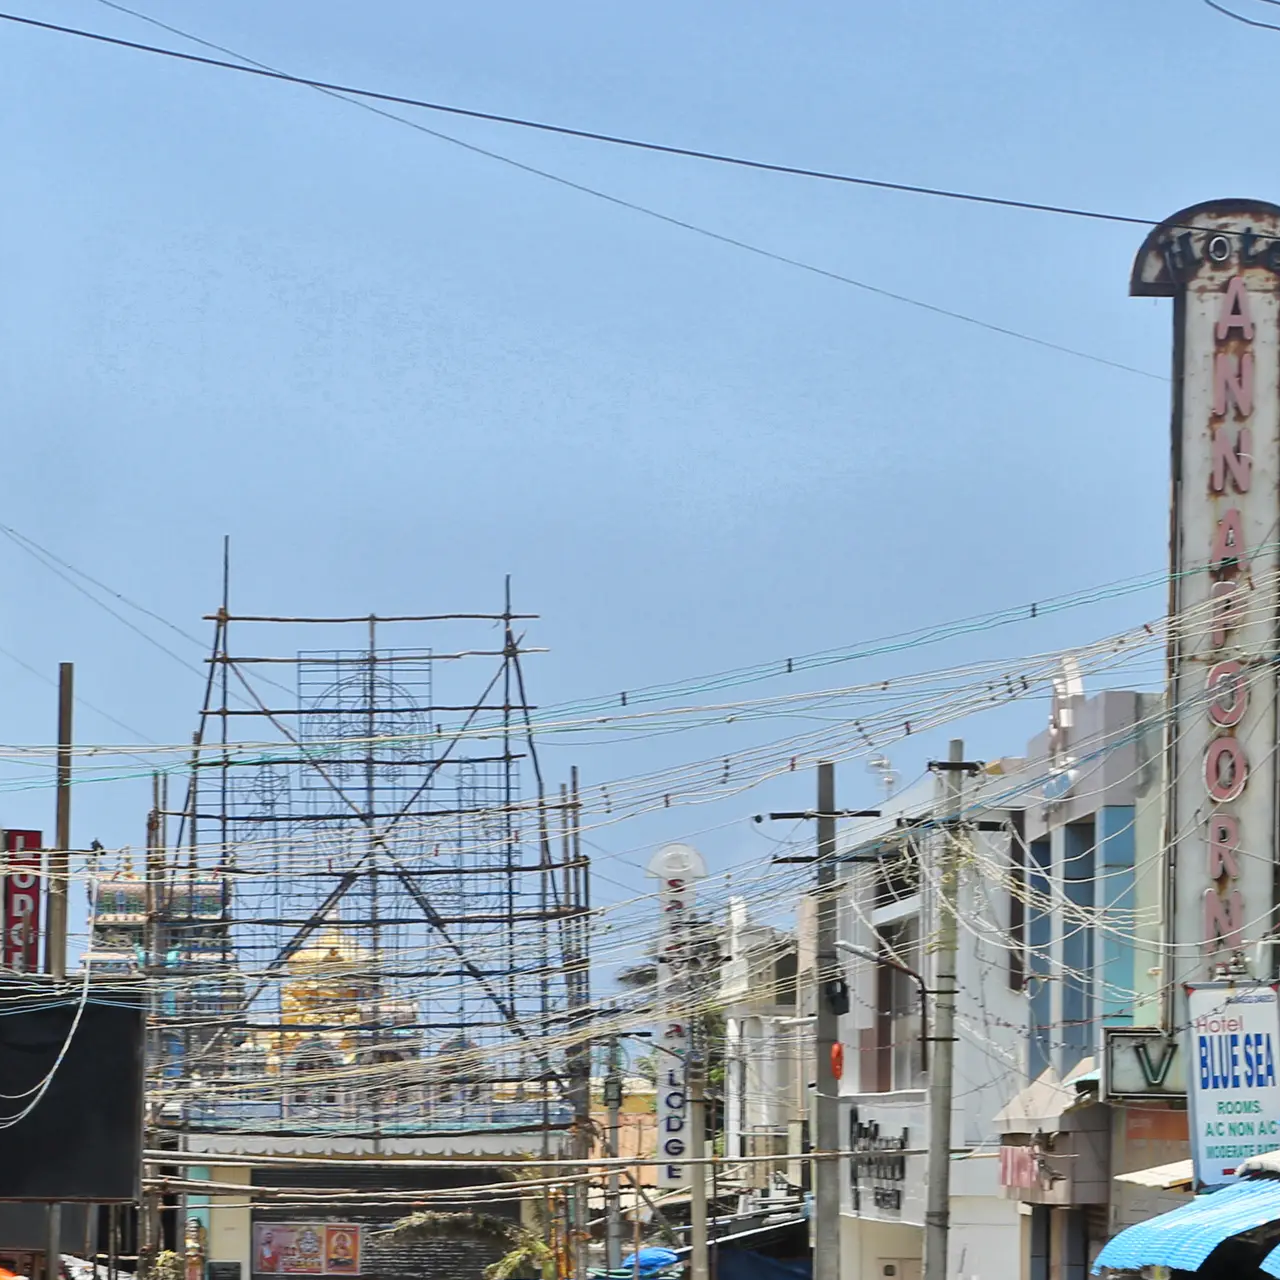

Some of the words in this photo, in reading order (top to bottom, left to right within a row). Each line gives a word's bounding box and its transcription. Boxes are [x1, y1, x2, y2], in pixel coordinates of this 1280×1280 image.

[1196, 1014, 1244, 1035] Hotel
[1198, 1033, 1241, 1090] BLUE
[1244, 1032, 1277, 1088] SEA
[664, 1068, 685, 1180] LODGE
[1228, 1121, 1255, 1137] NON
